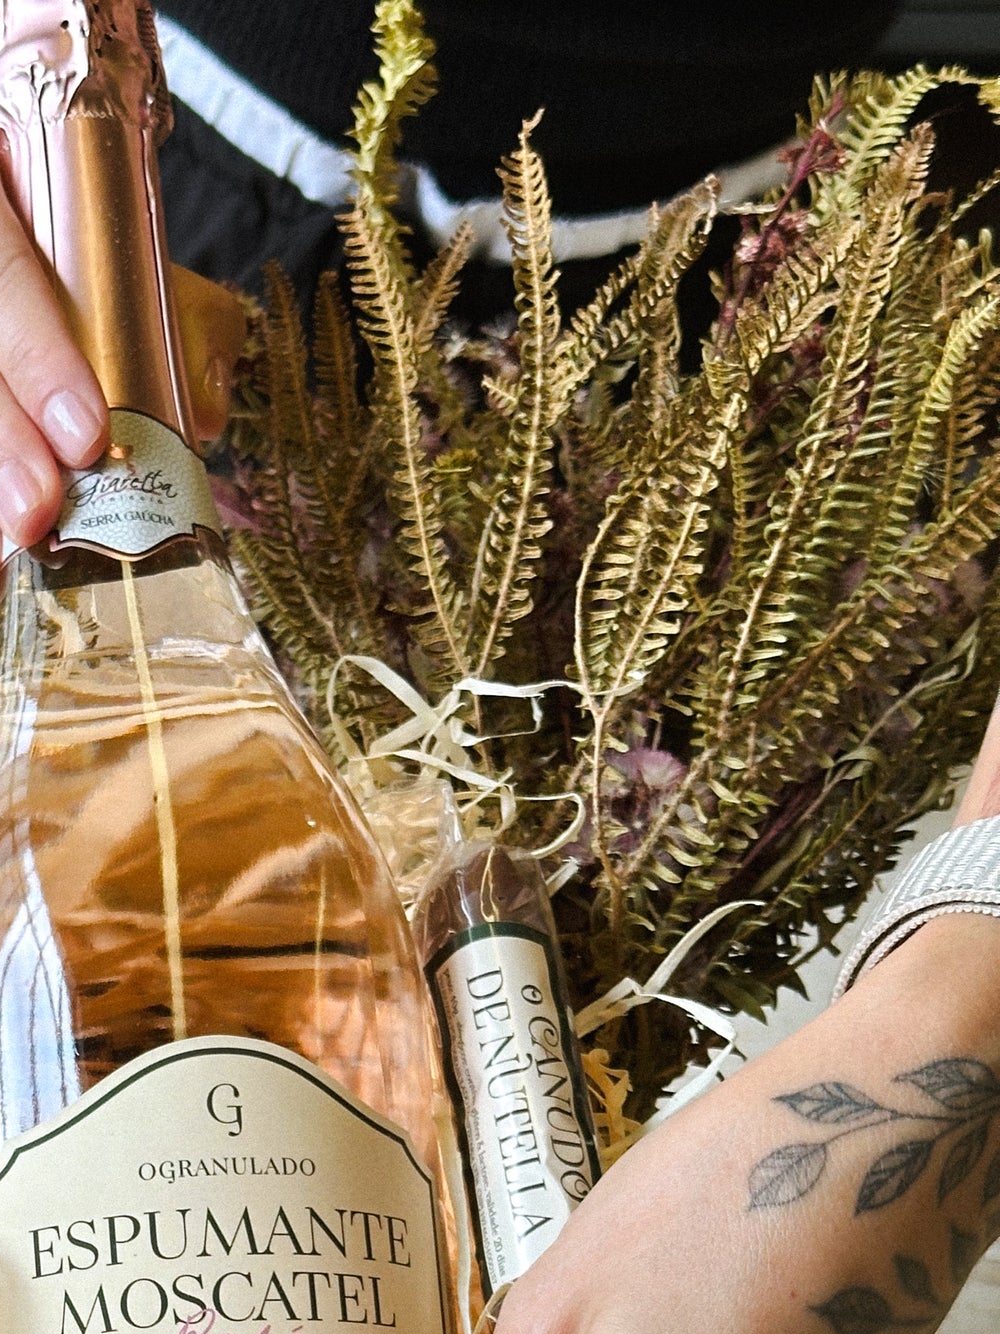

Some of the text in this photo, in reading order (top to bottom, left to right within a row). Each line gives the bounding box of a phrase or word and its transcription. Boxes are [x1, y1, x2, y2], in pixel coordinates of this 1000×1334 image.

[80, 510, 175, 530] SERRA GAÚCHA
[520, 984, 593, 1201] O CANUDO
[207, 1083, 243, 1137] G
[138, 1157, 316, 1184] OGRANULADO
[28, 1205, 412, 1280] ESPUMANTE
[493, 1236, 503, 1253] 20
[495, 1252, 506, 1277] dias
